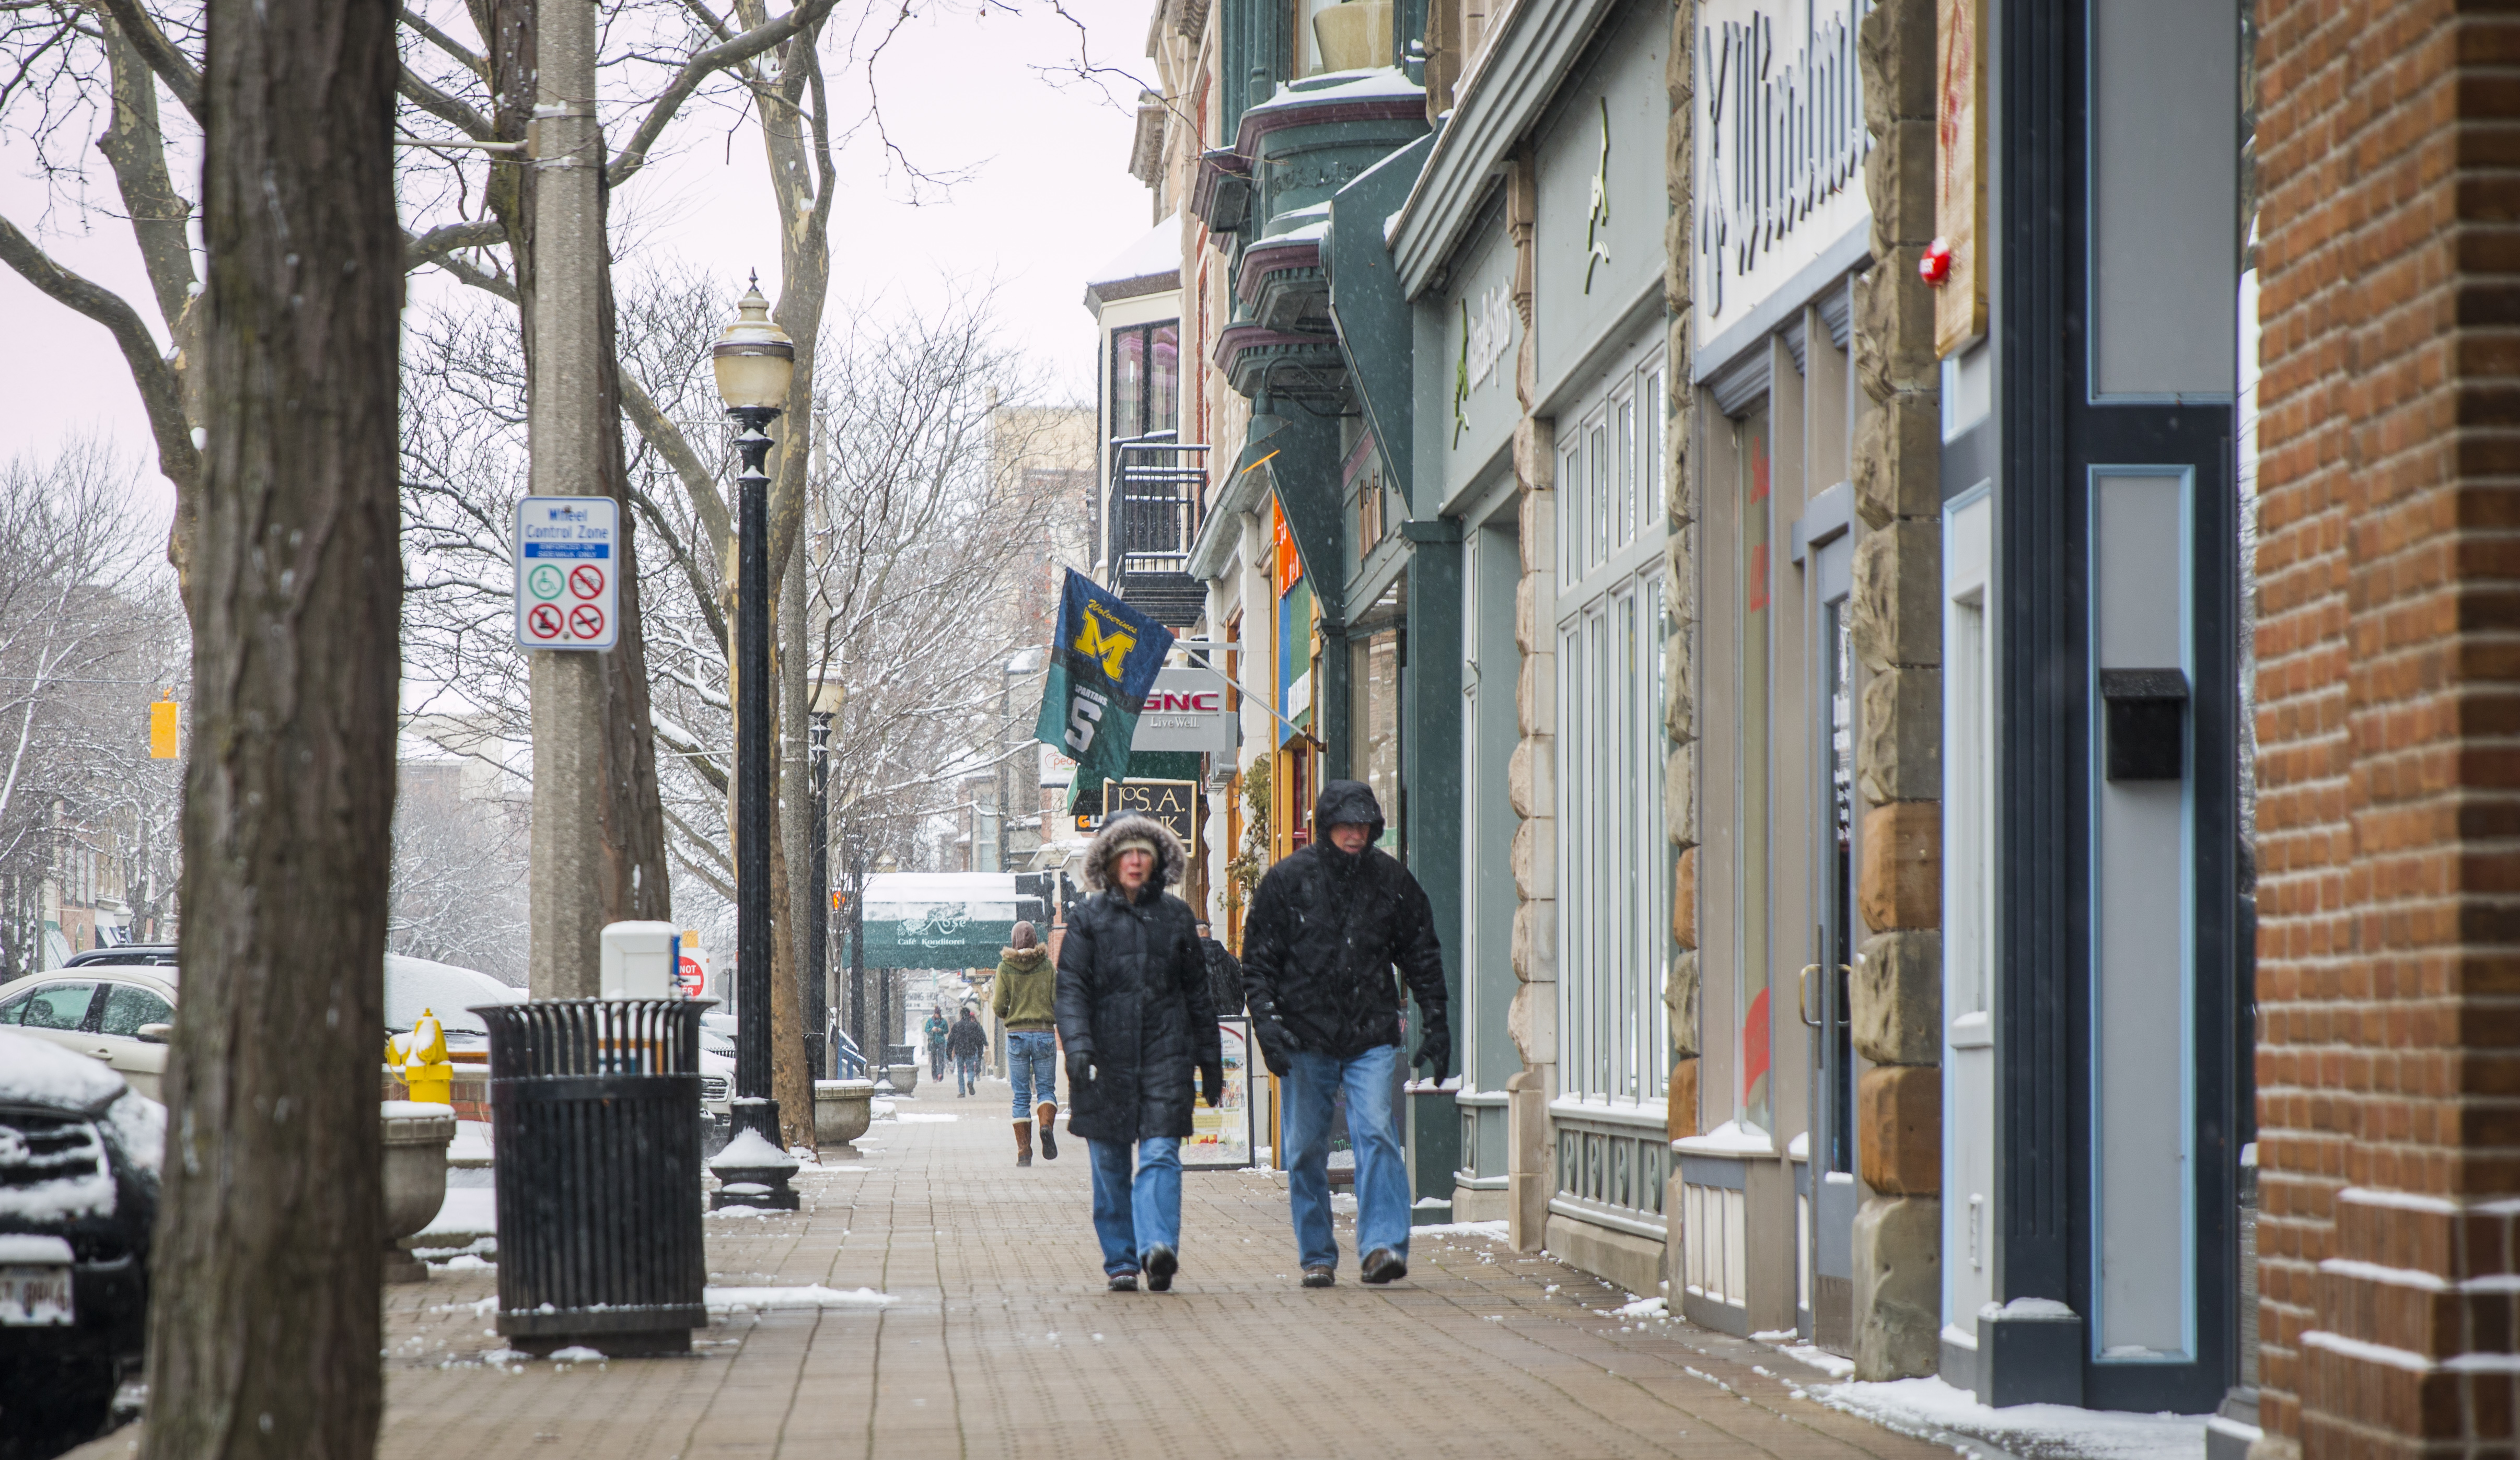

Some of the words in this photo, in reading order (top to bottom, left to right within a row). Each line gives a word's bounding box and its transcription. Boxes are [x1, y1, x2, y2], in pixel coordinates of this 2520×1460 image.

[549, 508, 587, 521] Wheel
[526, 524, 572, 538] Control
[578, 524, 608, 539] Zone
[1088, 599, 1137, 635] Wolverines
[1073, 606, 1137, 682] M
[1074, 683, 1108, 706] SPARTANS
[1143, 692, 1218, 711] GNC
[1064, 696, 1102, 753] S
[1150, 716, 1174, 727] Live
[1175, 716, 1200, 728] Well.
[1156, 788, 1186, 812] A.
[929, 912, 966, 935] Rose
[922, 938, 965, 948] Konditorei
[679, 965, 696, 974] NOT
